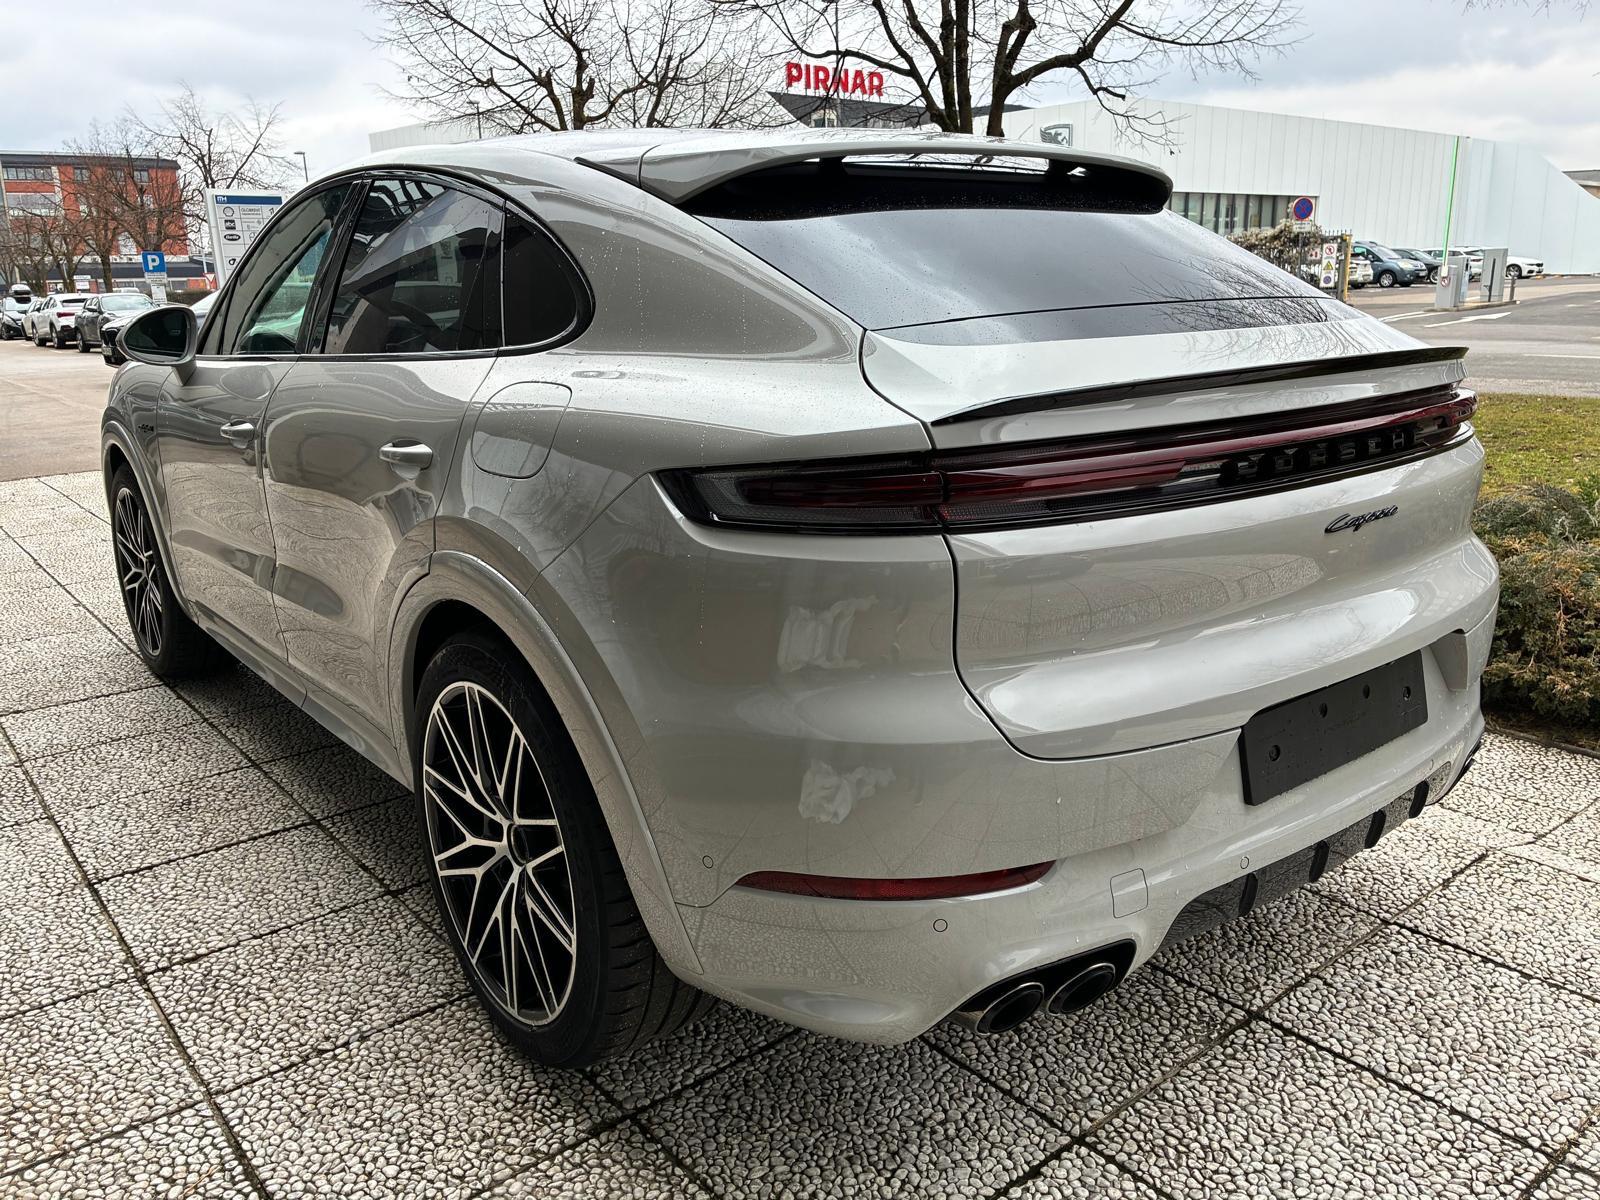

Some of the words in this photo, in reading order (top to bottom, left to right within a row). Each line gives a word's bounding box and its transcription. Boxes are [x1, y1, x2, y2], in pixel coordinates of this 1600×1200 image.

[785, 61, 884, 97] PIRNAR
[147, 254, 160, 270] P
[1324, 504, 1398, 533] Cayenne
